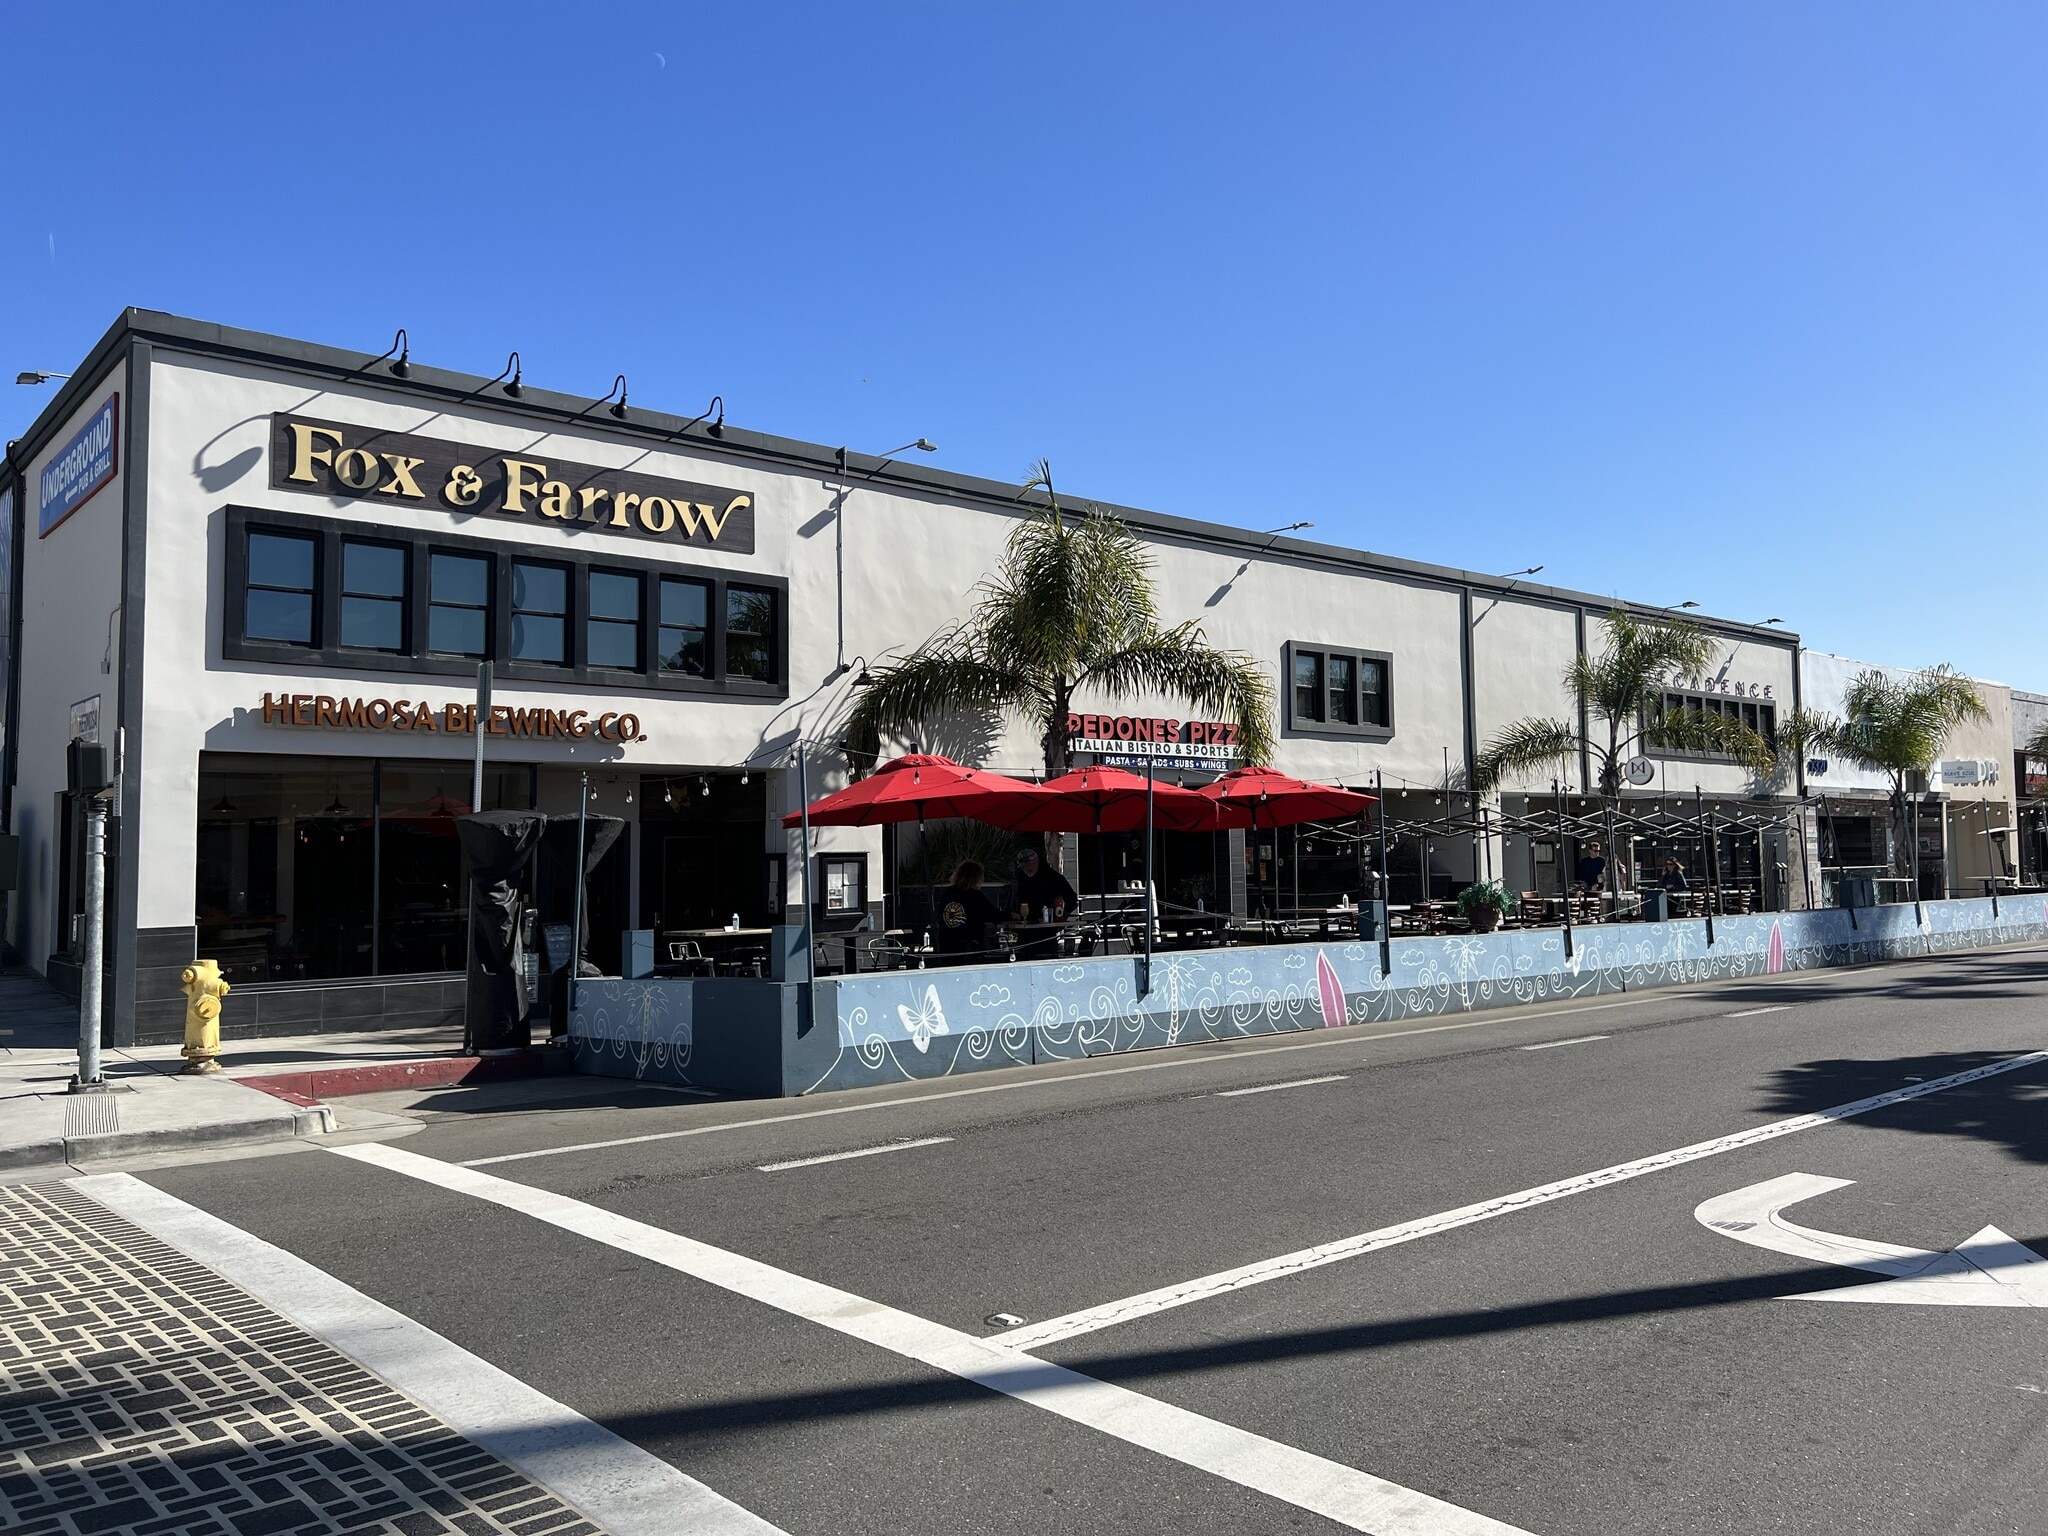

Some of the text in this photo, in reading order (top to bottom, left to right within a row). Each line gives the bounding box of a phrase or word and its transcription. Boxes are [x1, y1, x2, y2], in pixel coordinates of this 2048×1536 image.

[41, 408, 112, 509] UNDERGROUND
[78, 476, 89, 495] PUB
[94, 451, 111, 479] GRILL
[289, 423, 751, 541] Fox & Farrow
[1654, 669, 1774, 699] ECADENCE
[263, 692, 437, 731] HERMOSA
[598, 710, 648, 743] CO.
[1067, 712, 1240, 746] PEDONES PIZZ
[1105, 756, 1227, 769] PASTA SAADS SUBS WINGS
[1128, 742, 1171, 754] BISTRO
[1175, 744, 1182, 754] &
[1186, 745, 1229, 757] SPORTS
